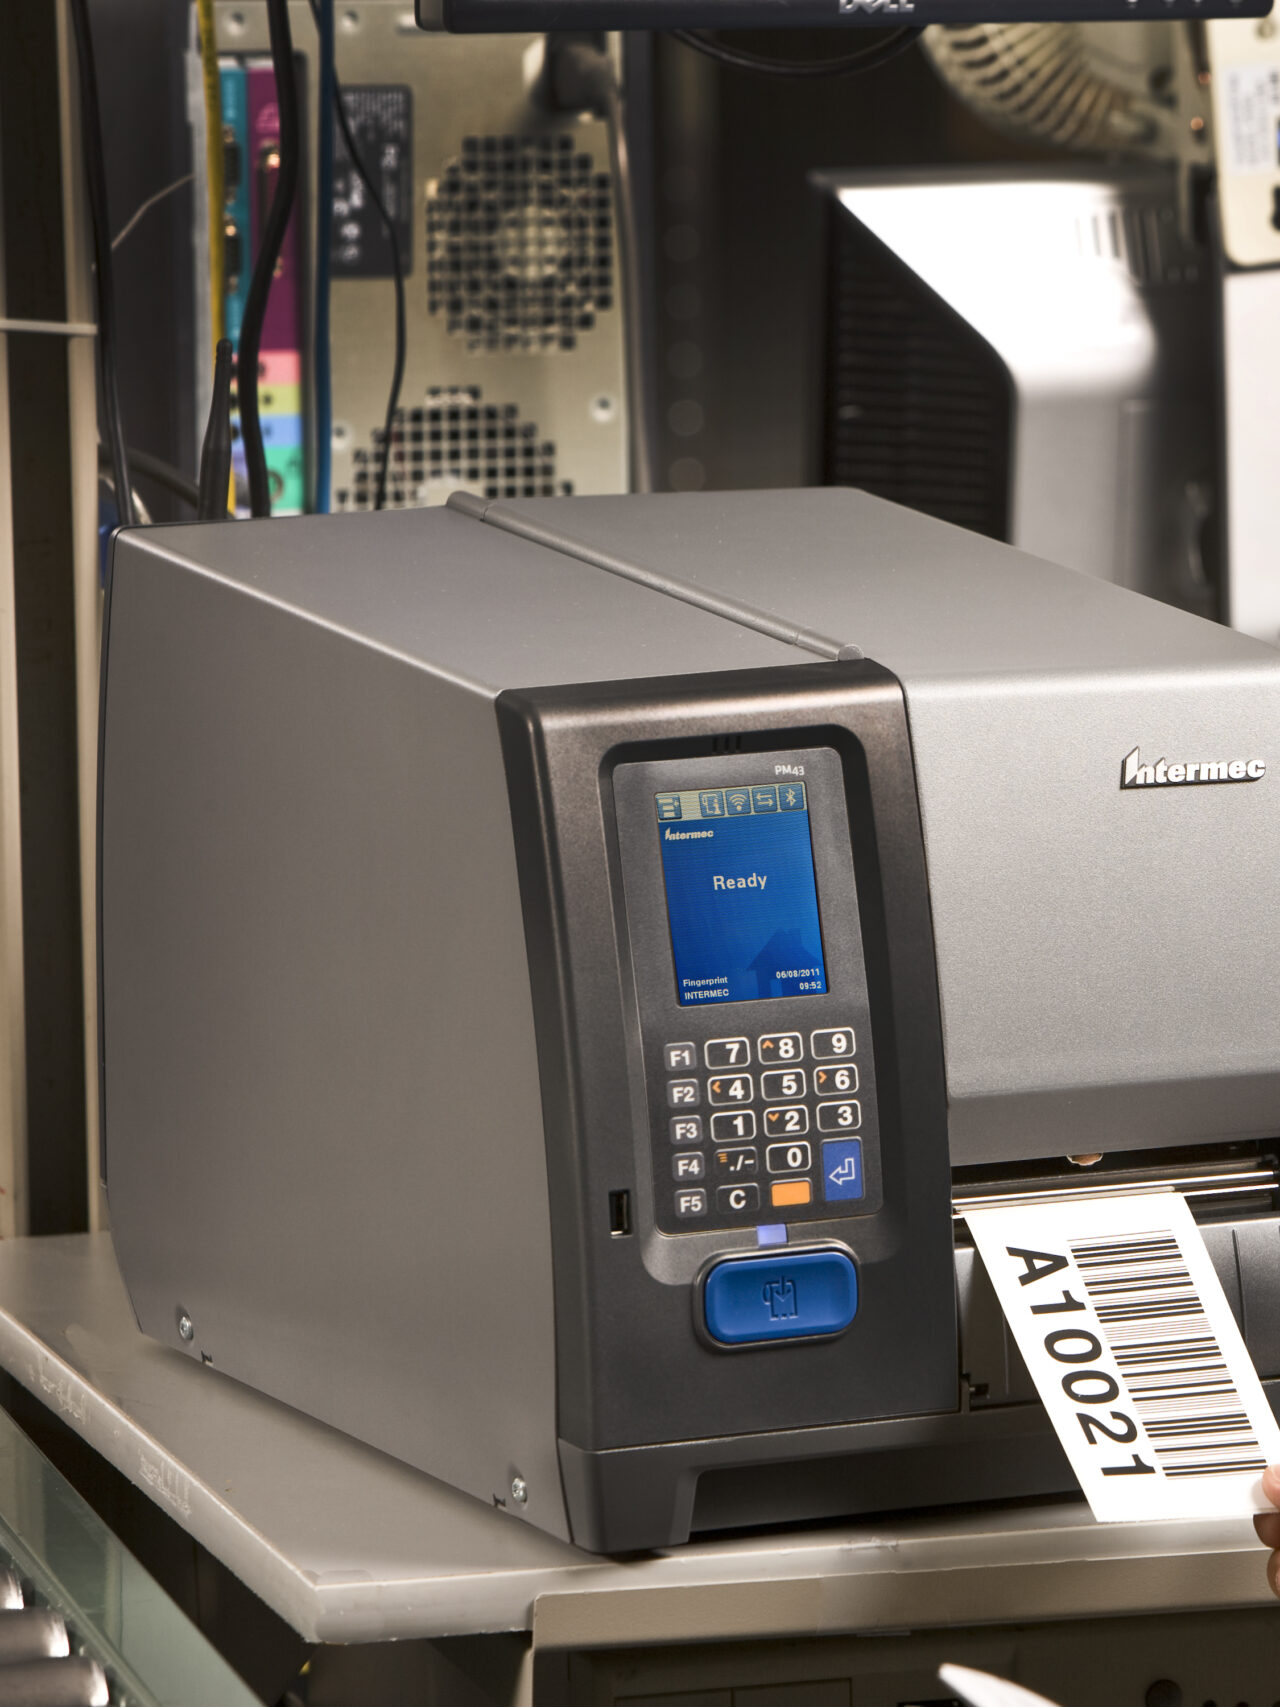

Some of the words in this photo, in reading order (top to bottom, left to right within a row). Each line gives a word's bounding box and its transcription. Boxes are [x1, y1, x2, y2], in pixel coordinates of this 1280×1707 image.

[774, 765, 805, 776] PM43
[1120, 745, 1267, 789] Intermec
[664, 827, 714, 841] Intermec
[713, 872, 768, 891] Ready
[683, 976, 728, 988] Fingerprint
[776, 968, 820, 979] 06/08/2011
[684, 988, 729, 1000] INTERMEC
[799, 981, 822, 991] 09:52
[670, 1050, 691, 1067] F1
[725, 1043, 740, 1064] 7
[779, 1038, 794, 1059] 8
[831, 1033, 847, 1054] 9
[672, 1086, 695, 1104] F2
[728, 1079, 745, 1100] 4
[782, 1075, 798, 1095] 5
[835, 1070, 851, 1091] 6
[675, 1123, 698, 1140] F3
[732, 1116, 744, 1136] 1
[784, 1111, 800, 1131] 2
[837, 1106, 853, 1126] 3
[677, 1160, 700, 1176] F4
[787, 1147, 802, 1168] 0
[680, 1196, 702, 1213] F5
[729, 1190, 746, 1210] C
[1005, 1245, 1156, 1478] A10021
